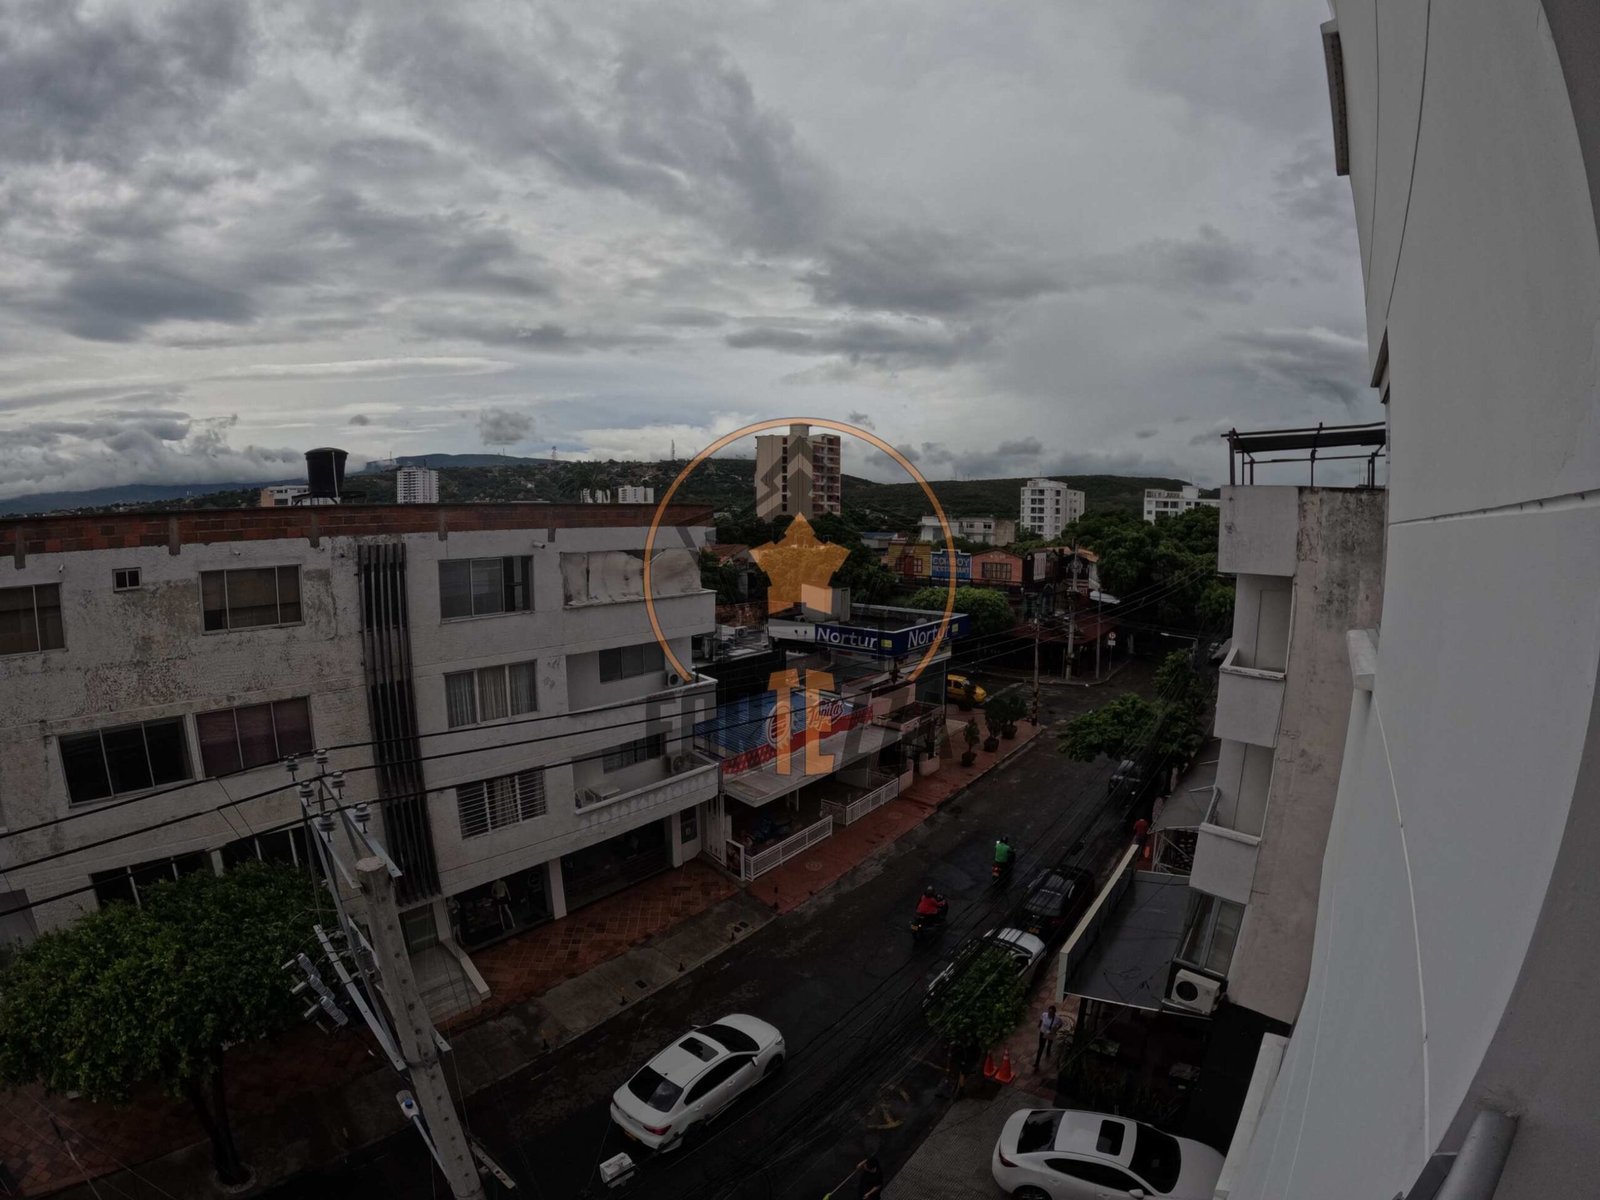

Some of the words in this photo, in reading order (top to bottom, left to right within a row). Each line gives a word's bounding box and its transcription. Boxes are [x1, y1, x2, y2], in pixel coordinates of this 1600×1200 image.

[932, 556, 970, 567] COWOY
[816, 627, 877, 648] Nortur
[907, 622, 950, 648] Nortur
